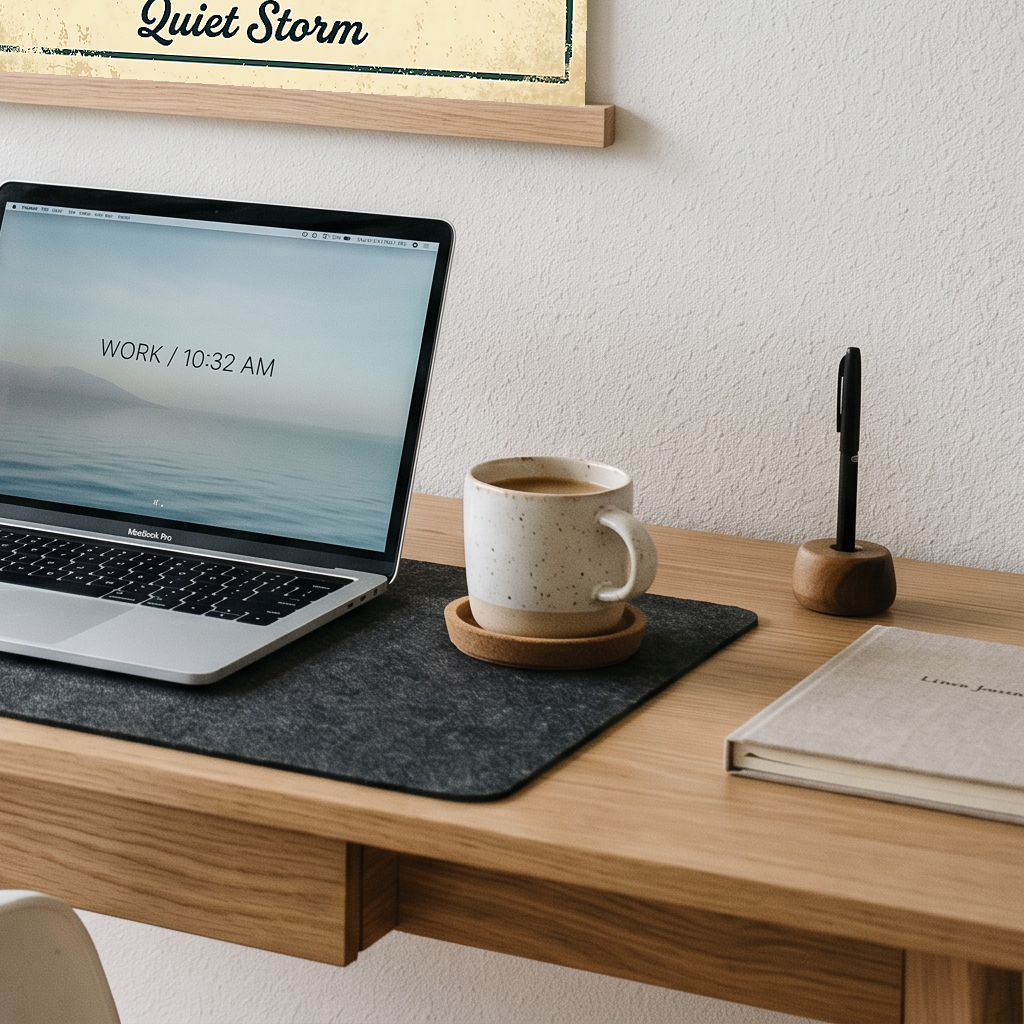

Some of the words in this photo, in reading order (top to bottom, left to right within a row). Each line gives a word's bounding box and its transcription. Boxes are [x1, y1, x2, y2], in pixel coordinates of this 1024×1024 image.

[246, 0, 370, 46] Storm
[101, 338, 164, 364] WORK
[183, 349, 236, 373] 10:32
[240, 355, 276, 378] AM
